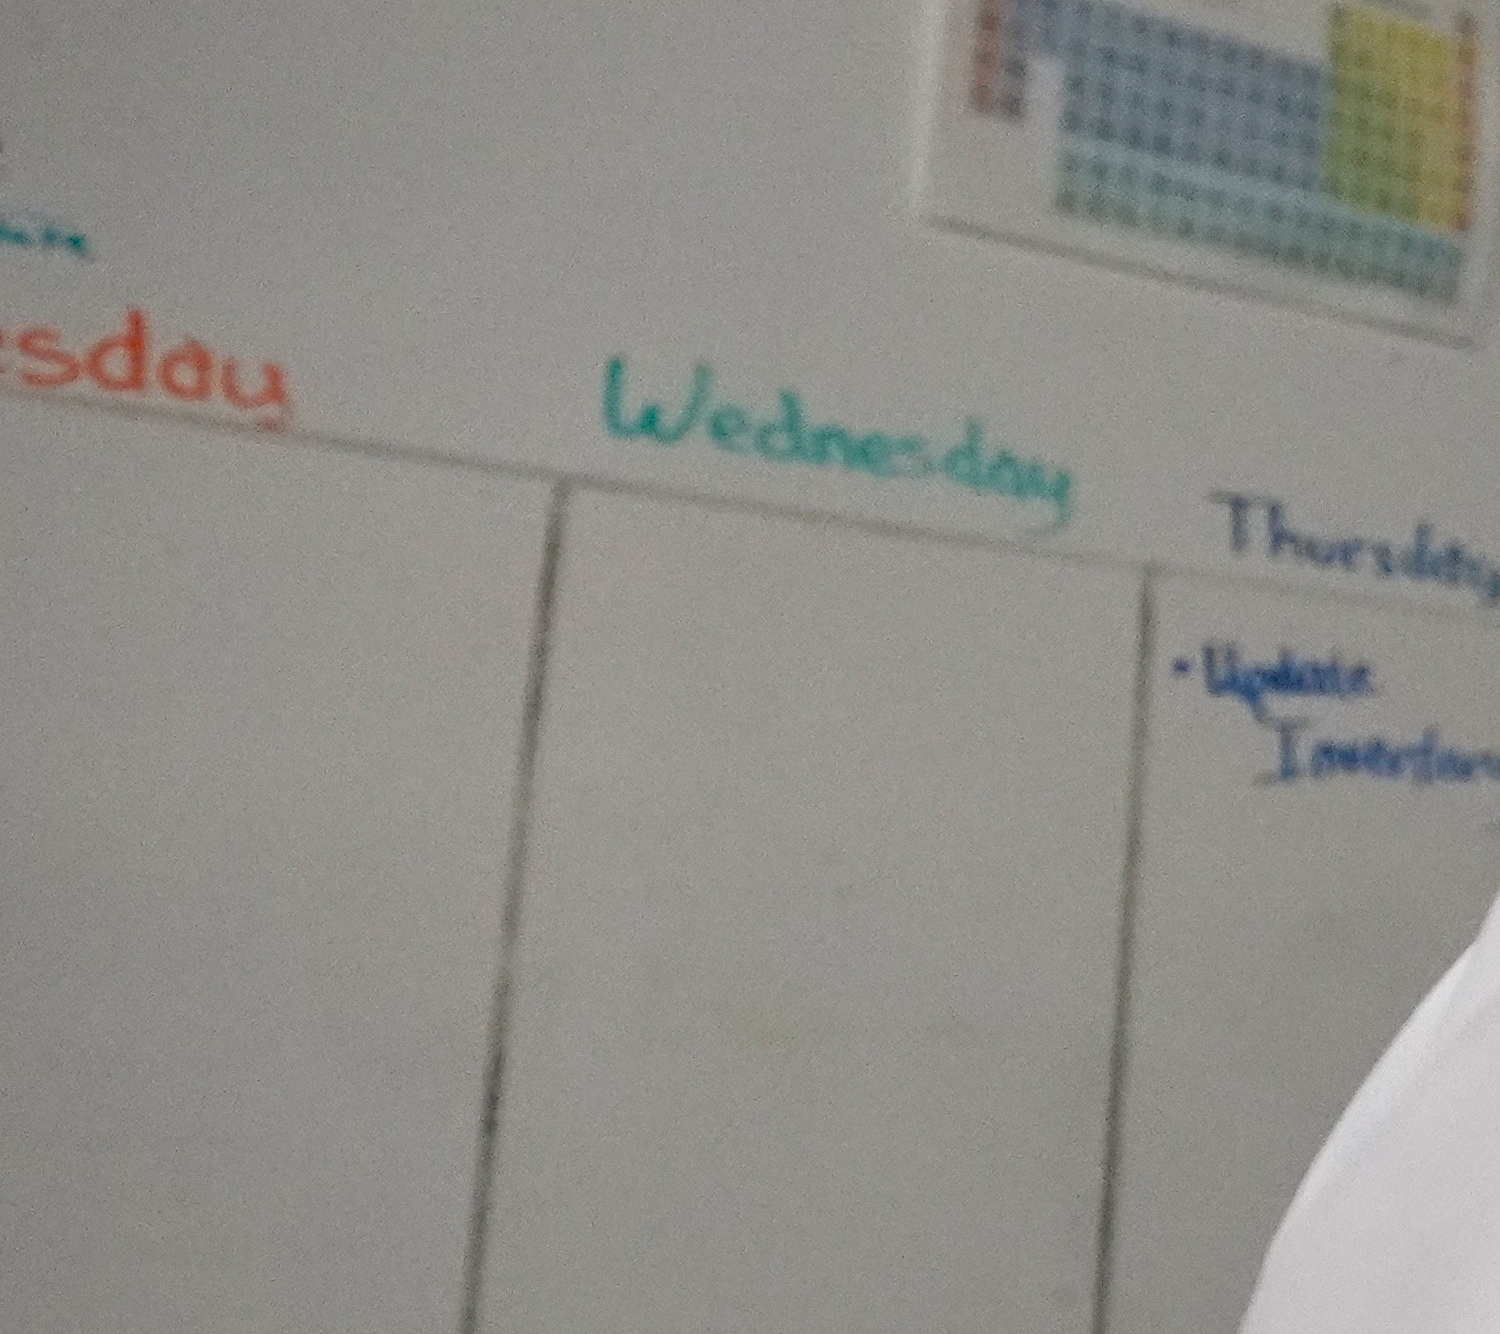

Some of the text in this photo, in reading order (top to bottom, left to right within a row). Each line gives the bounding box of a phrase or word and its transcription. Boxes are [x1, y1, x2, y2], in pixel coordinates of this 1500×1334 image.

[0, 307, 290, 431] sday
[602, 353, 1073, 539] Wednesday
[1200, 640, 1377, 729] Update
